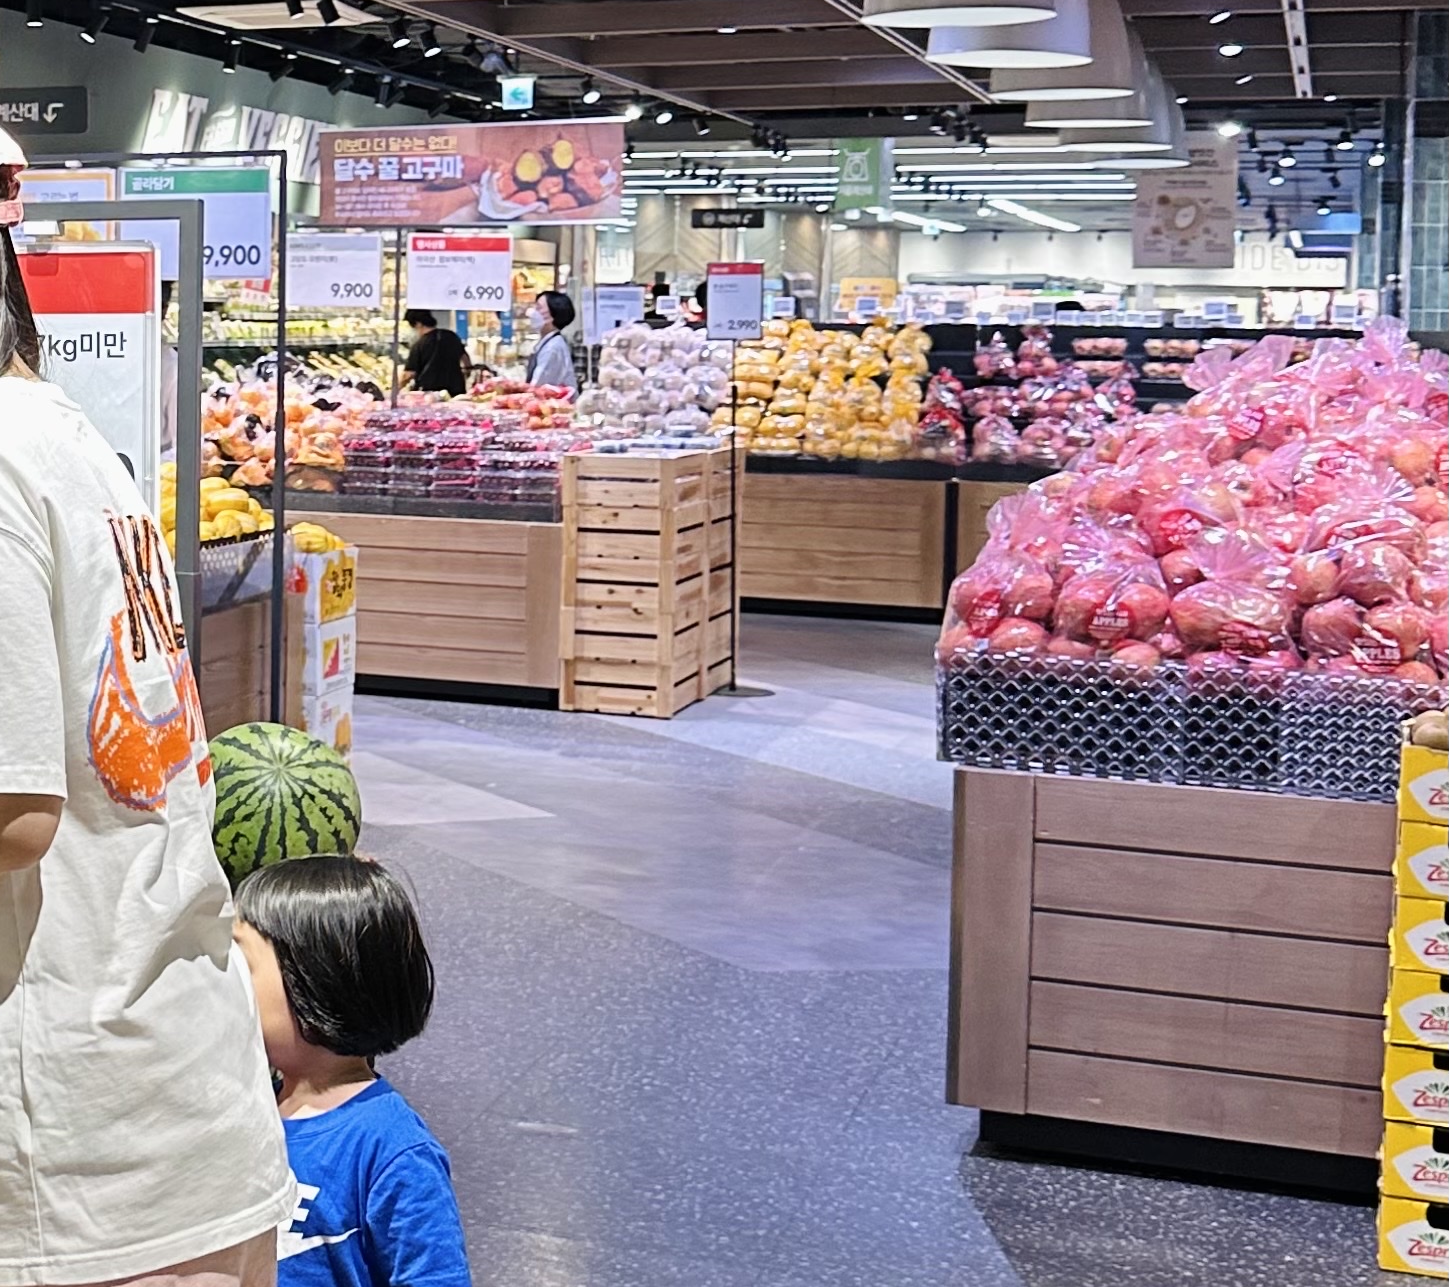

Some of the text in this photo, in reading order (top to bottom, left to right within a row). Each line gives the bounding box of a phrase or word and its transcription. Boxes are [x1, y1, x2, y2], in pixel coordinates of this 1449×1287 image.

[236, 105, 330, 185] VEGGIE
[330, 283, 373, 298] 9,900
[463, 286, 504, 300] 6,990
